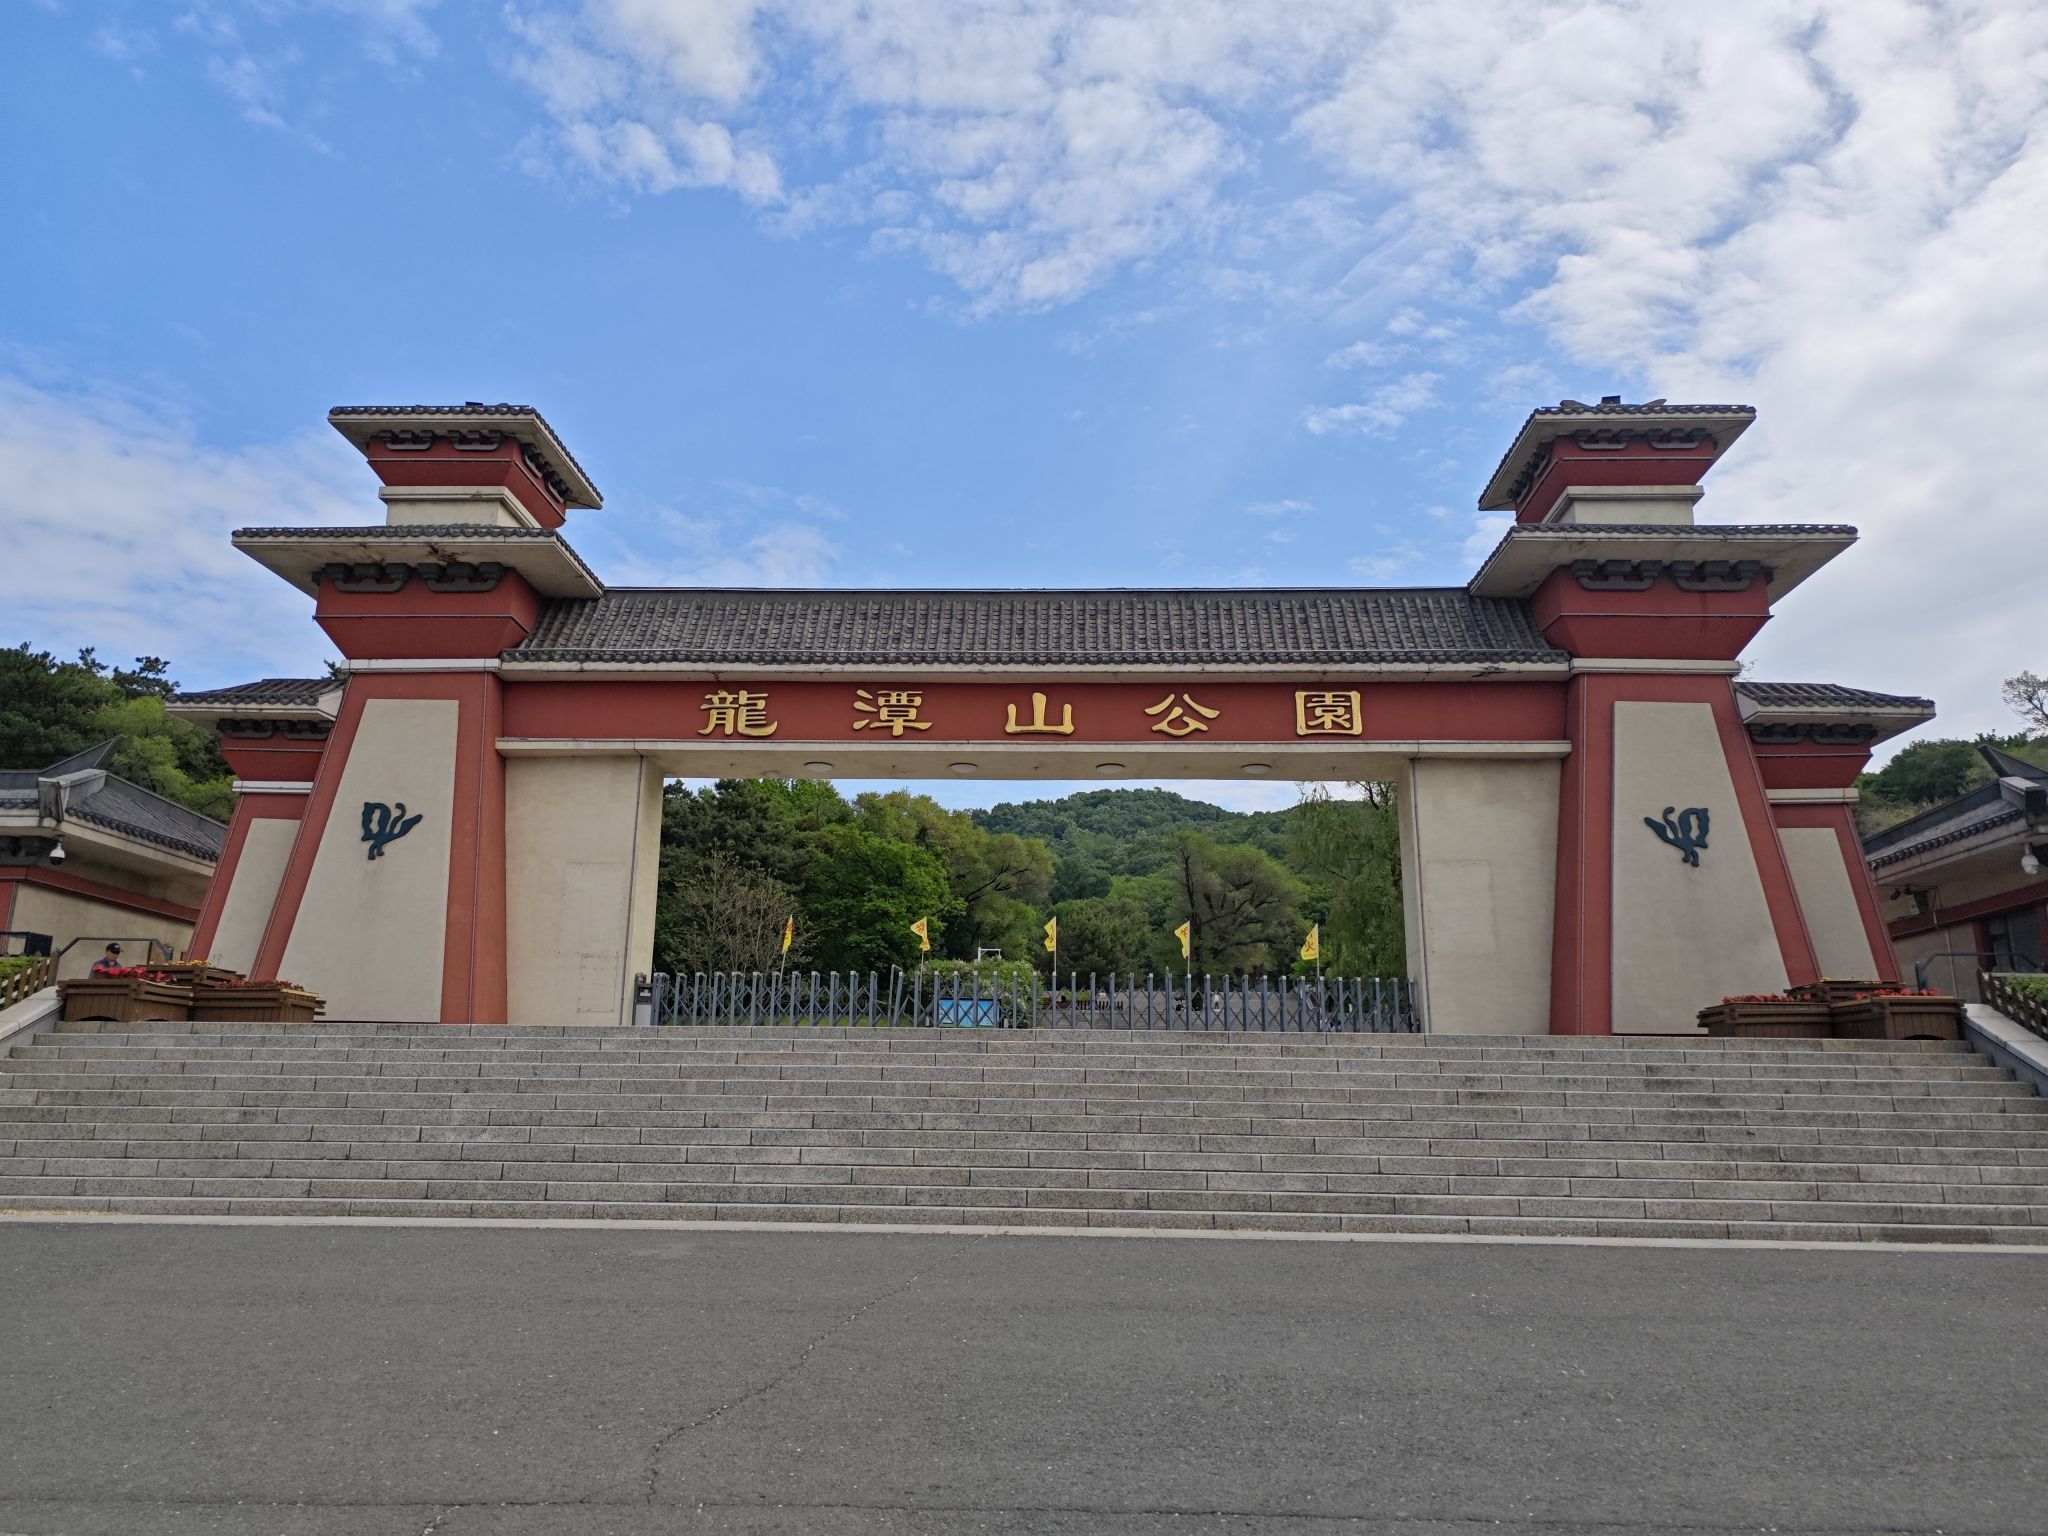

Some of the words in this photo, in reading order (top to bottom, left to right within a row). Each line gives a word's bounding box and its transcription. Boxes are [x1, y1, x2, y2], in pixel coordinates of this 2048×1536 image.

[698, 689, 1363, 737] 龍潭山公園
